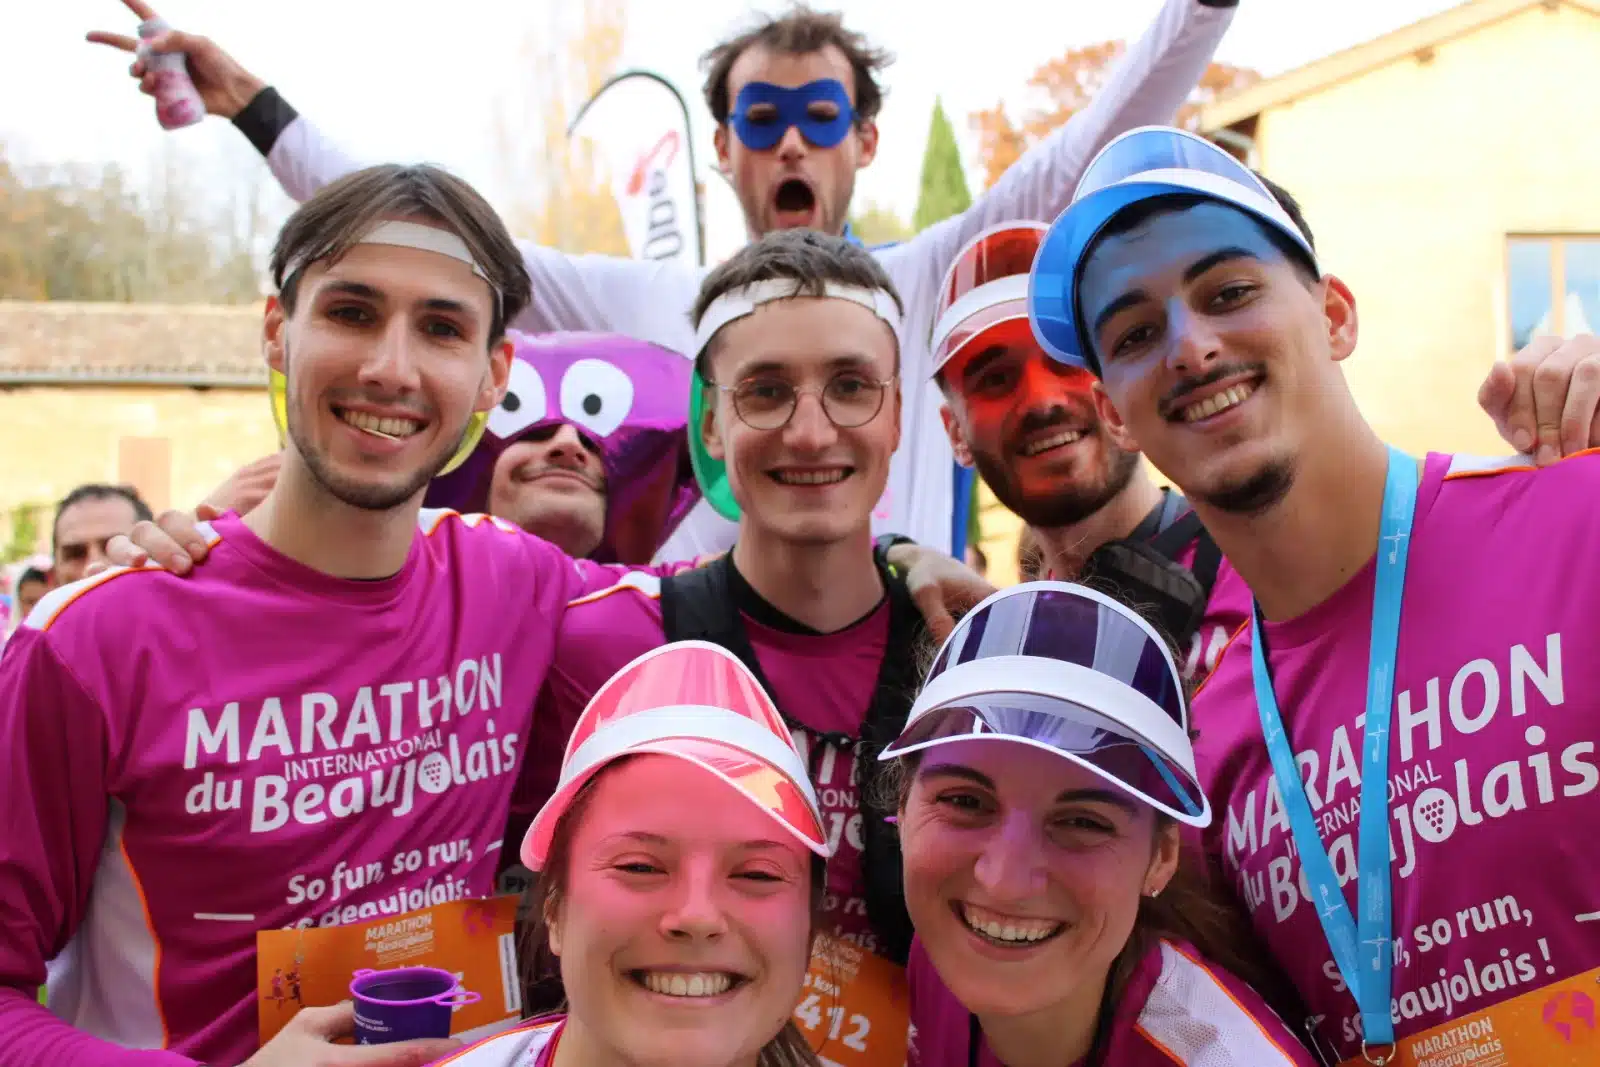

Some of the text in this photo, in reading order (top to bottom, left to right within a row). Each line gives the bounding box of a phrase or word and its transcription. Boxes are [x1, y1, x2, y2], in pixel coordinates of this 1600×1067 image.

[184, 652, 502, 770] MARATHON
[185, 718, 519, 833] du Beaujolais
[284, 729, 444, 782] INTERNATIONAL
[1226, 632, 1565, 871] MARAHON
[1268, 725, 1600, 923] Bajolais
[286, 874, 326, 904] So
[391, 849, 423, 876] so
[1414, 917, 1451, 953] so
[1456, 894, 1534, 939] run,
[1390, 947, 1537, 1026] eaujolais
[1411, 1016, 1494, 1059] MARATHON
